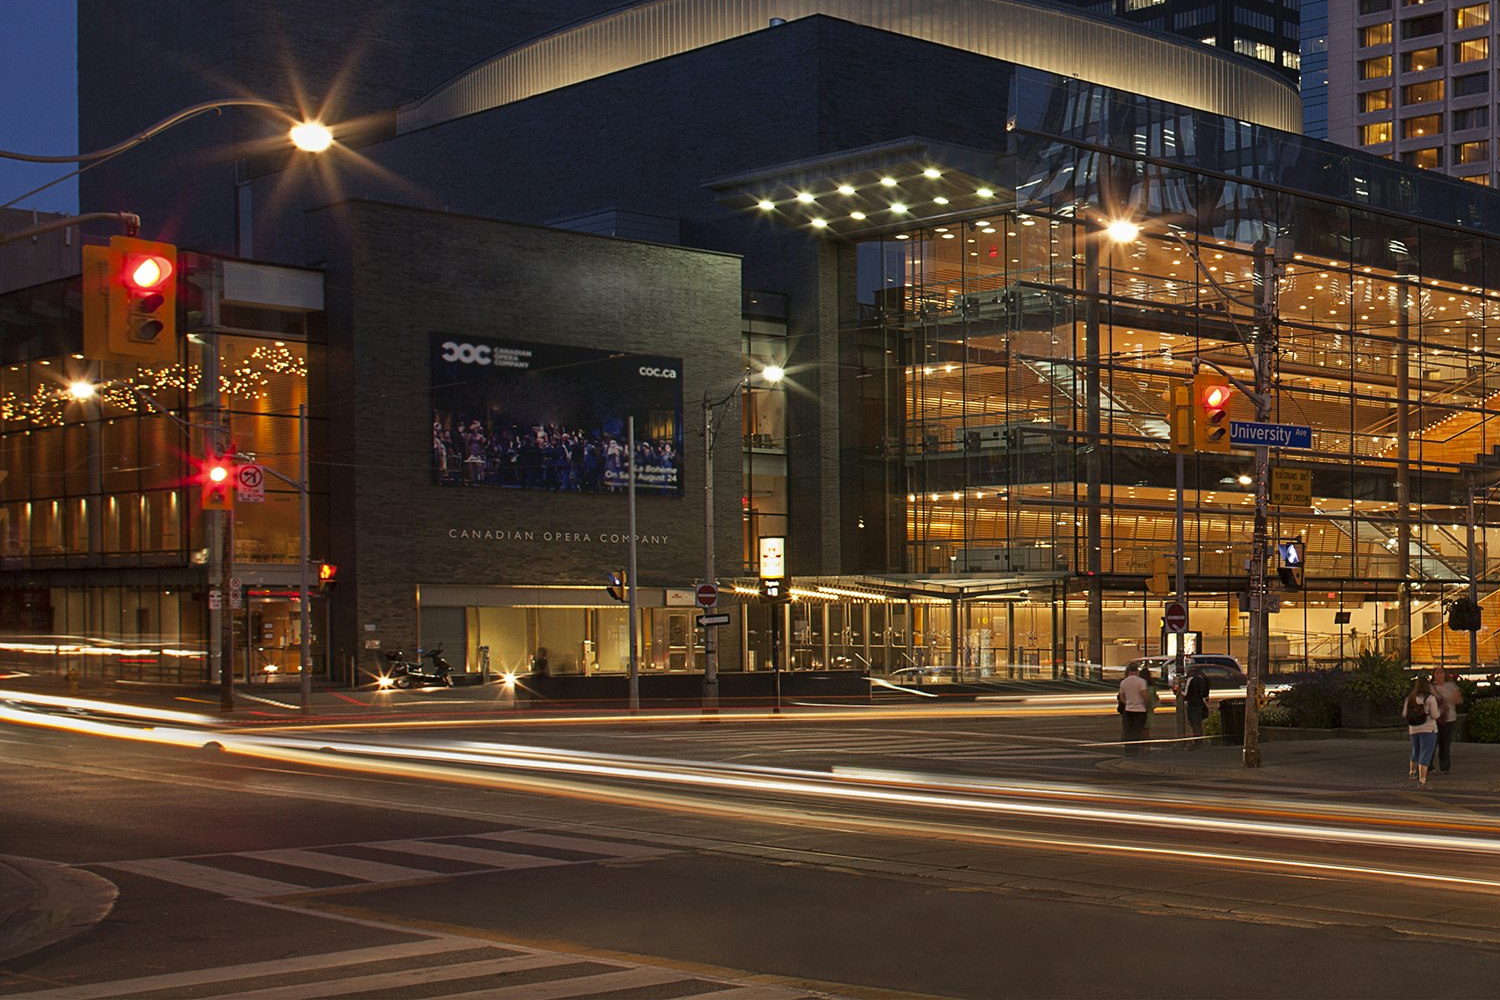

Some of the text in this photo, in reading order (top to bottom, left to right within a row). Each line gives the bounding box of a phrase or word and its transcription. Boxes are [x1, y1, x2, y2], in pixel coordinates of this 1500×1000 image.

[494, 360, 529, 369] COMPANY
[639, 366, 677, 379] coc.ca
[1230, 423, 1307, 445] University Ave
[605, 470, 617, 479] On
[449, 529, 669, 544] CANADIAN OPERA COMPANY
